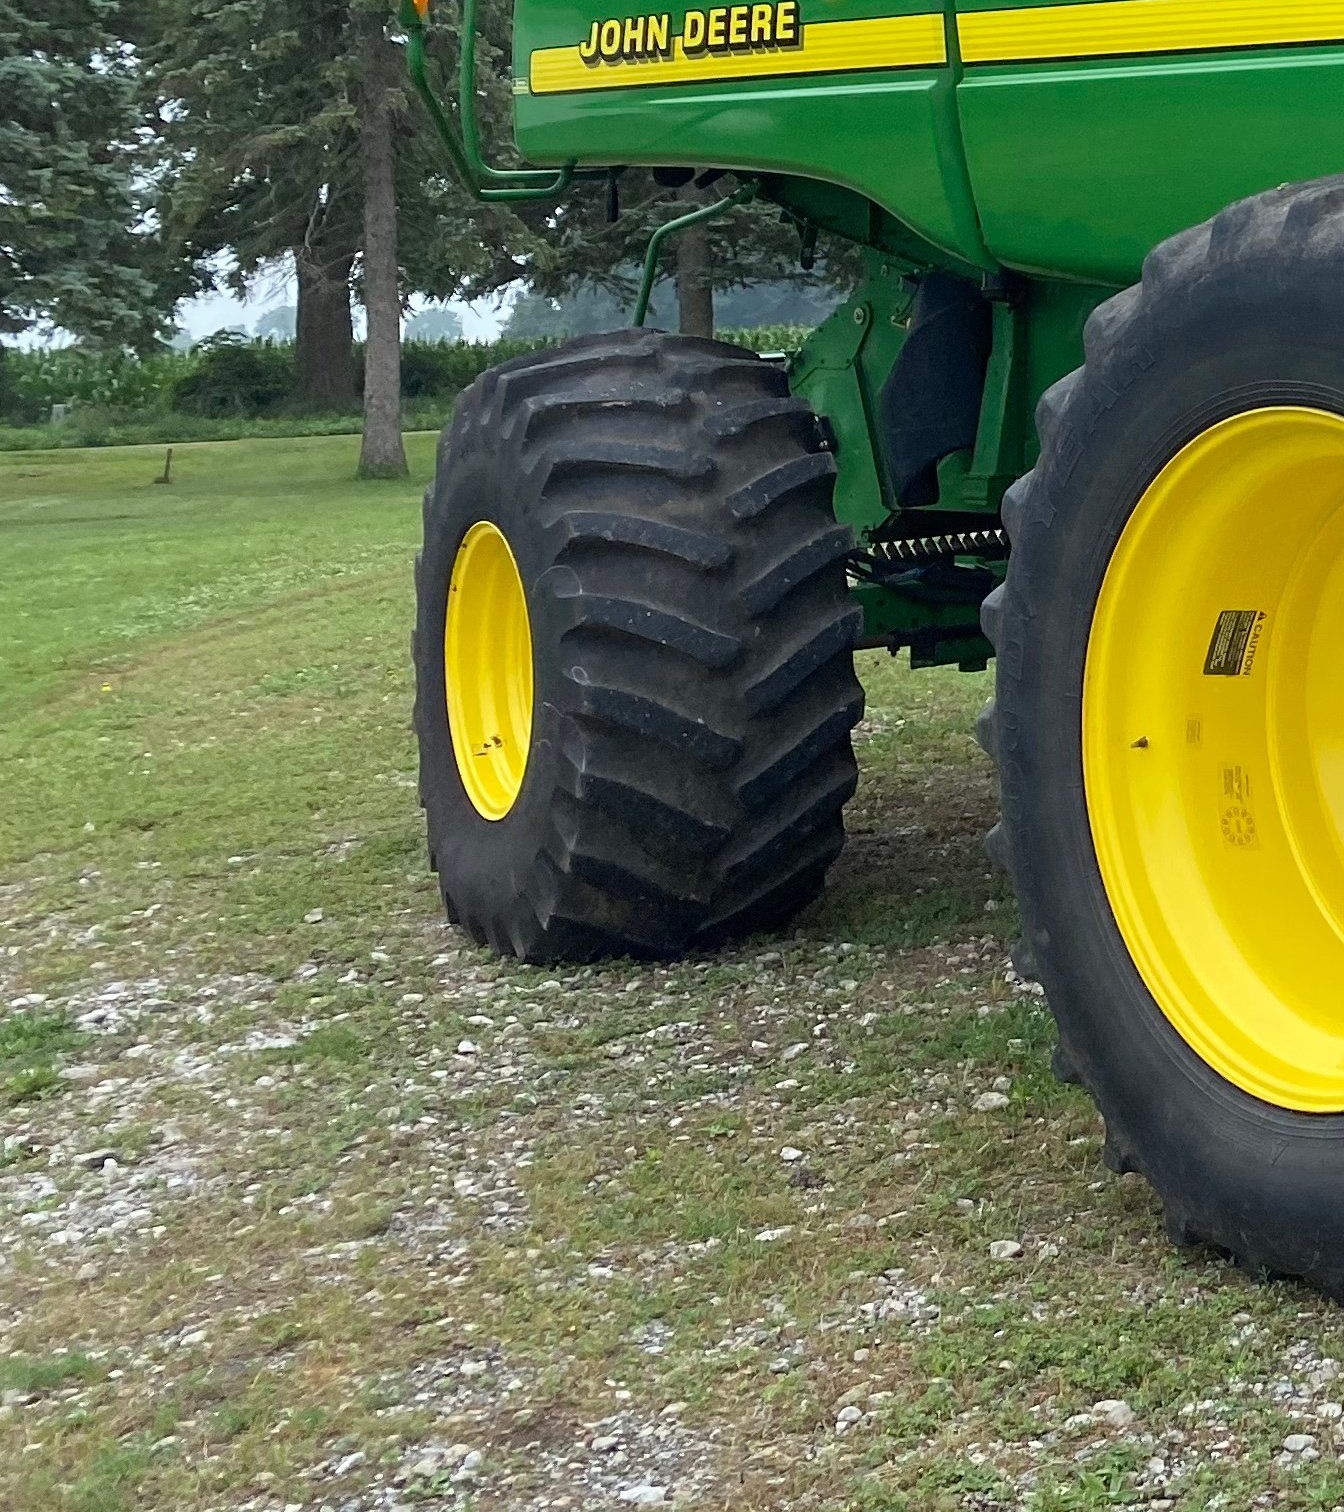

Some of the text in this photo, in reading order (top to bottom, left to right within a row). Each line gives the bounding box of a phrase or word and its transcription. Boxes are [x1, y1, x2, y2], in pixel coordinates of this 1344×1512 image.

[580, 0, 800, 65] JOHN DEERE
[1243, 624, 1263, 676] CAUTION
